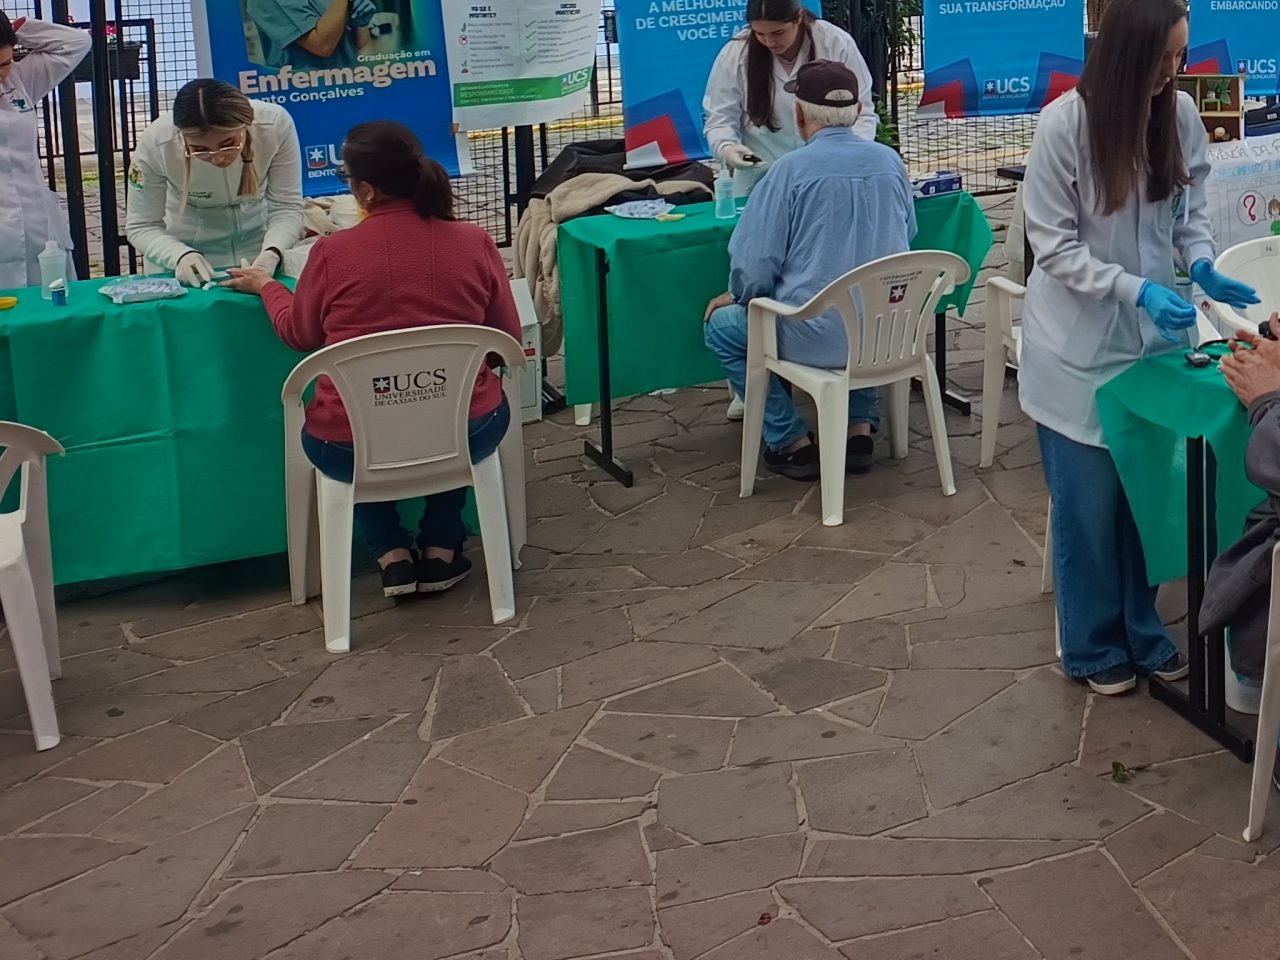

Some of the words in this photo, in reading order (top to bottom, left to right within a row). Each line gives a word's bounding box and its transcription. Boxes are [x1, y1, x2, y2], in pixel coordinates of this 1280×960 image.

[649, 2, 660, 14] A
[939, 3, 963, 15] SUA
[1210, 0, 1278, 11] EMBARCANDO
[635, 17, 656, 30] DE
[659, 10, 748, 28] CRESCIMENT
[677, 25, 717, 41] VOCÊ
[721, 24, 730, 38] É
[357, 50, 413, 63] Graduação
[414, 49, 431, 58] em
[1247, 58, 1277, 74] UCS
[239, 59, 437, 95] Enfermagem
[568, 68, 589, 85] UCS
[996, 76, 1030, 94] UCS
[289, 87, 365, 103] Gonçalves
[392, 368, 447, 392] UCS
[374, 385, 447, 401] UNIVERSIDADE
[387, 397, 418, 406] CAXIAS
